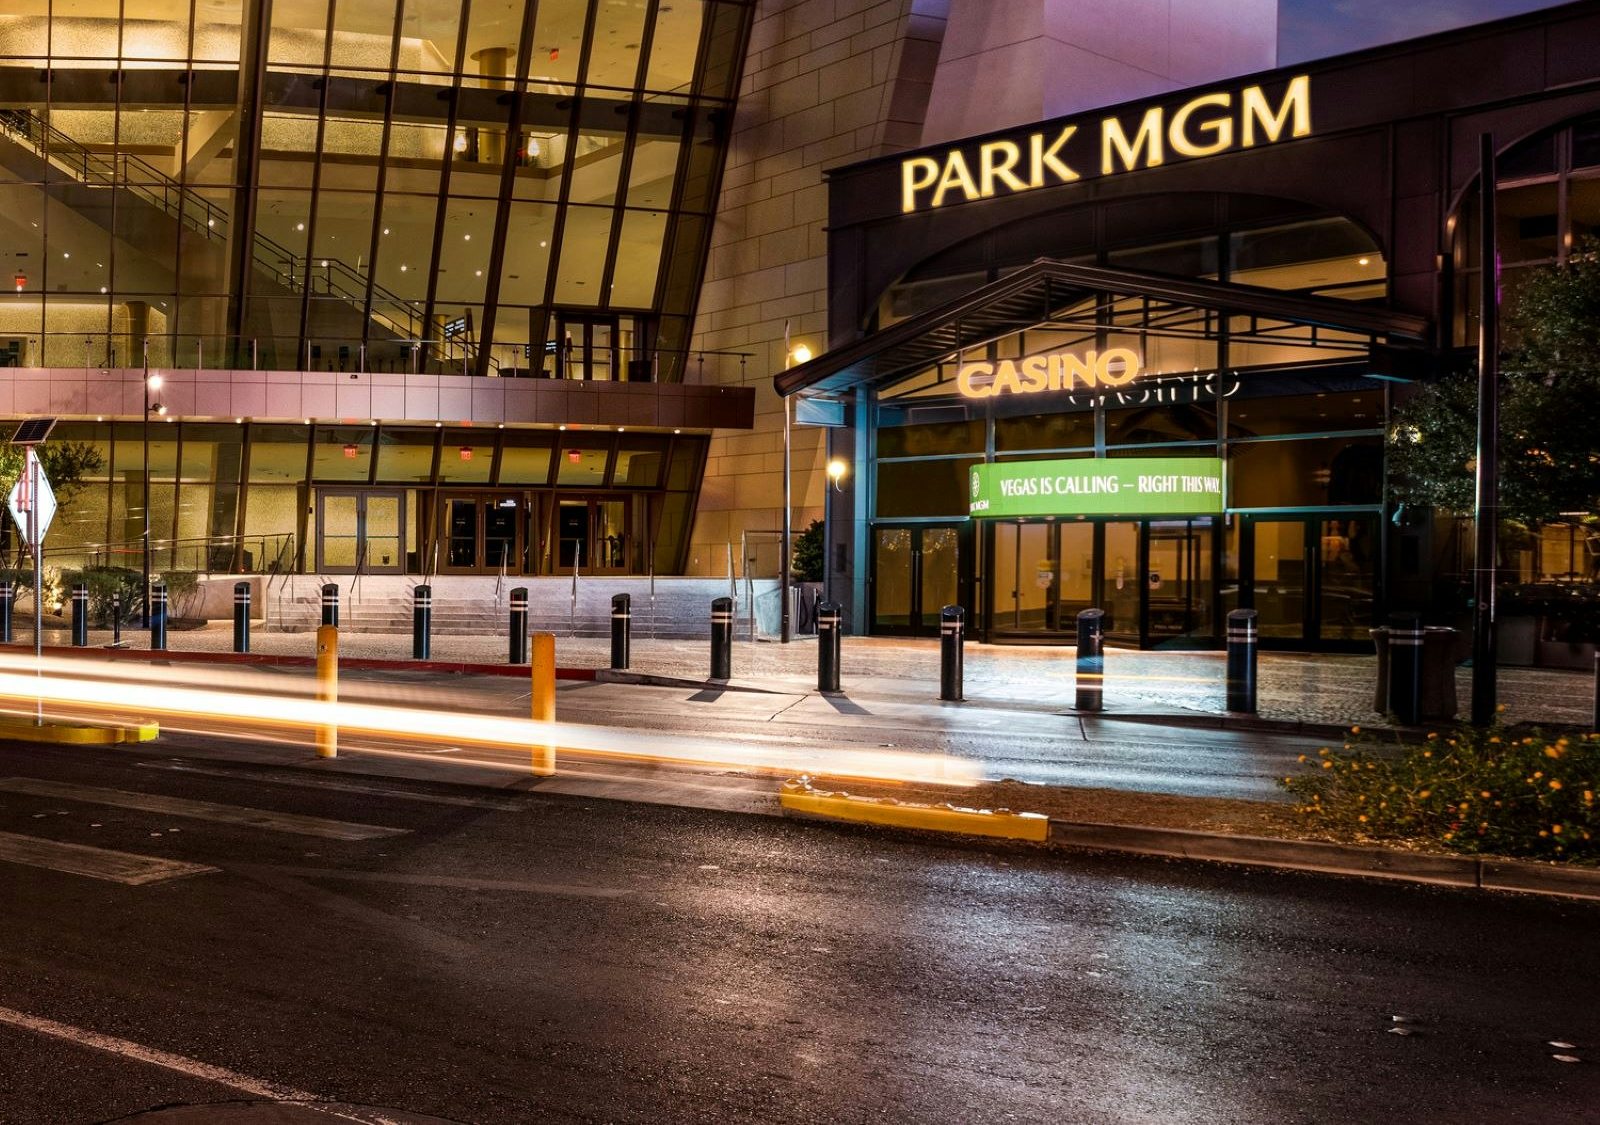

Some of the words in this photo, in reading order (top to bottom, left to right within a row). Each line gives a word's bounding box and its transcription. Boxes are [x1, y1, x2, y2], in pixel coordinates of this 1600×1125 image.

[902, 126, 1081, 213] PARK
[1102, 75, 1312, 175] MGM
[958, 348, 1140, 398] CASINO
[1000, 477, 1038, 496] VEGAS
[1040, 476, 1053, 495] IS
[1055, 475, 1119, 494] CALLING
[1138, 475, 1179, 494] RIGHT
[1180, 475, 1203, 493] THIS
